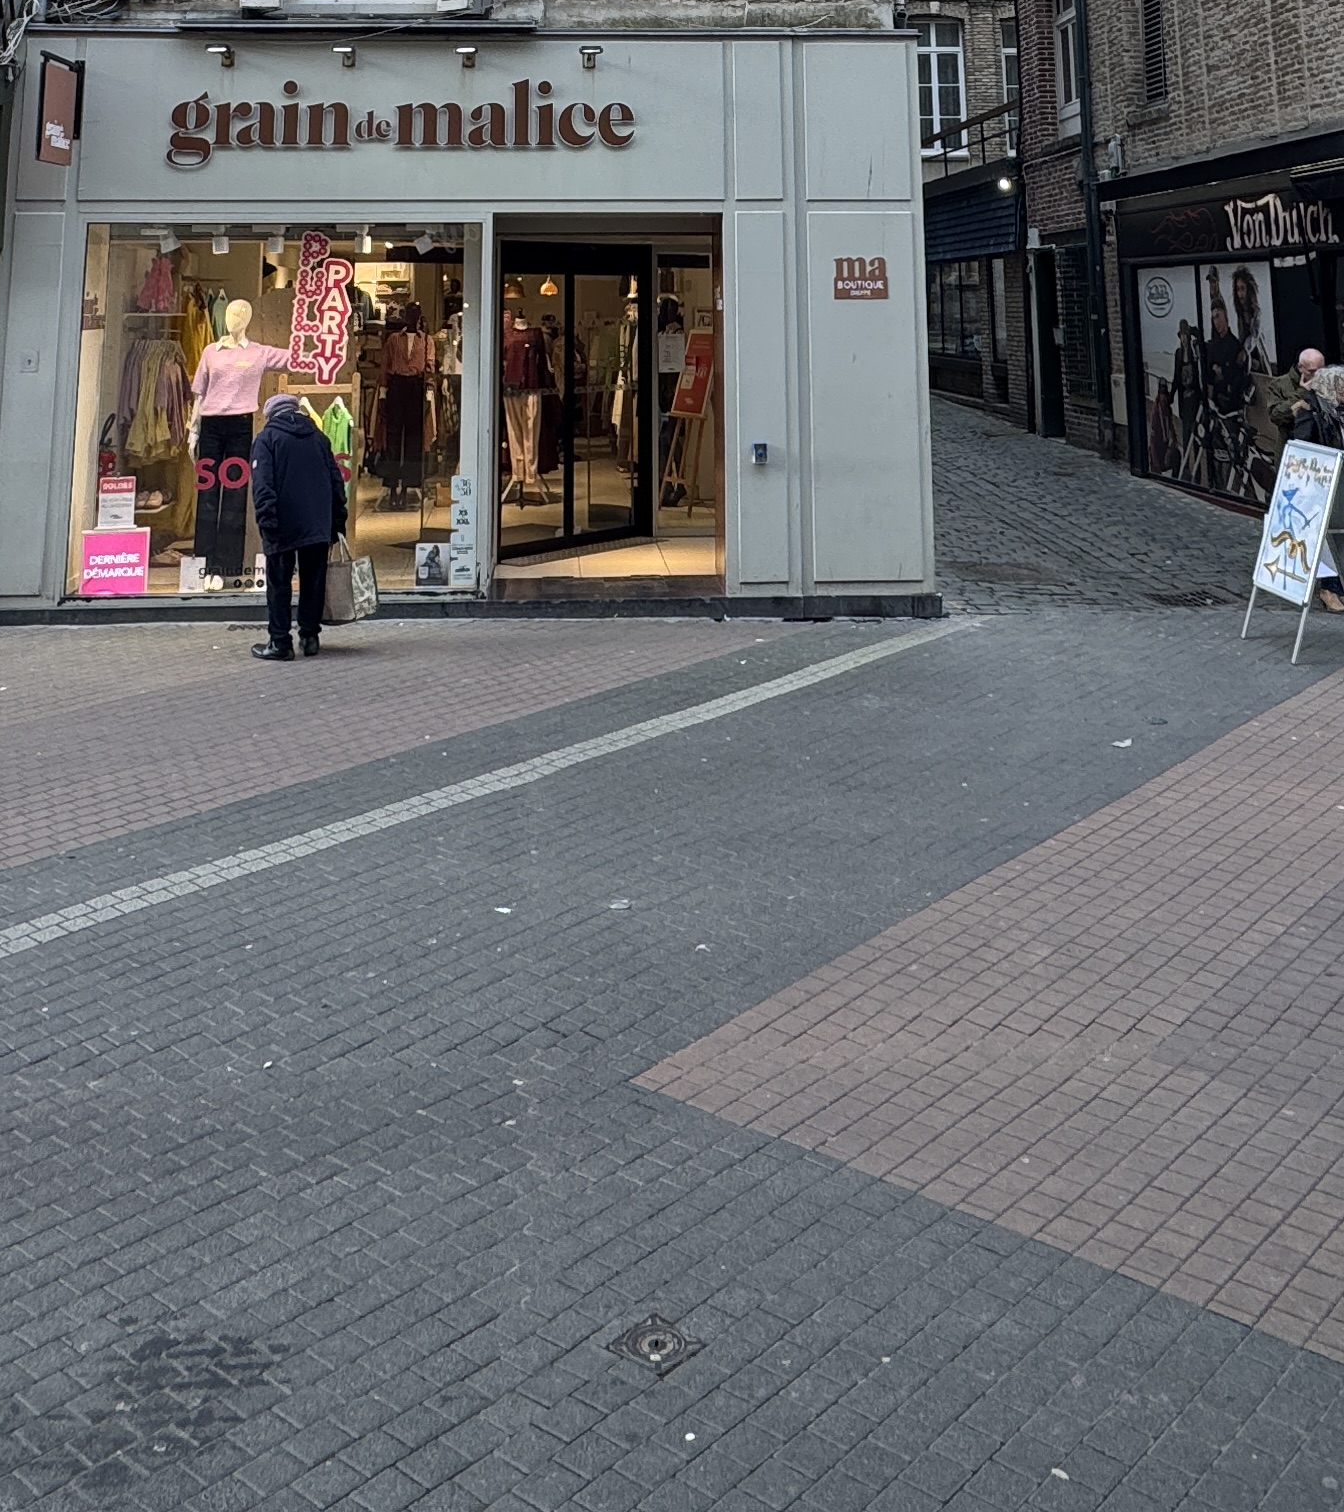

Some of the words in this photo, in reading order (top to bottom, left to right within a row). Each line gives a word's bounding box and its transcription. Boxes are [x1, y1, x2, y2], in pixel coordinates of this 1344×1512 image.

[166, 79, 352, 167] grain
[355, 109, 393, 141] de
[394, 78, 636, 148] malice
[833, 256, 886, 279] ma
[837, 280, 885, 290] BOUTIQUE
[313, 260, 352, 384] PARTY
[193, 454, 352, 490] SOS
[88, 552, 141, 566] DERNIÈRE
[83, 564, 145, 580] DÉMARQUE
